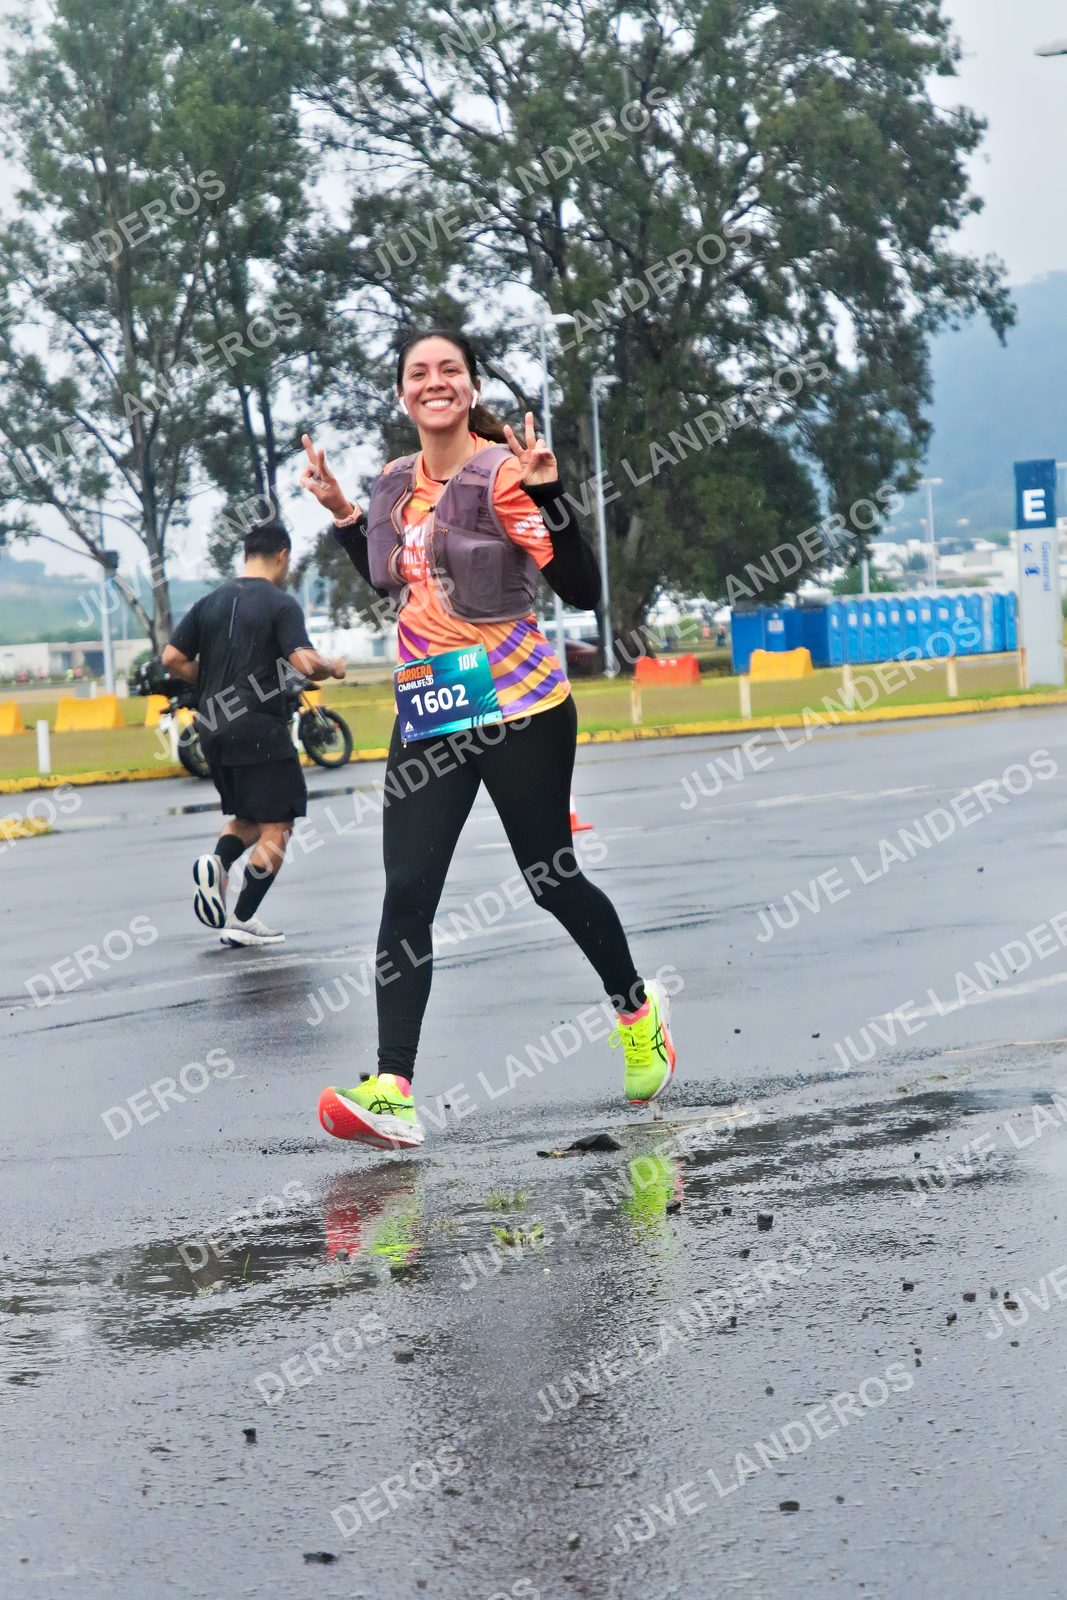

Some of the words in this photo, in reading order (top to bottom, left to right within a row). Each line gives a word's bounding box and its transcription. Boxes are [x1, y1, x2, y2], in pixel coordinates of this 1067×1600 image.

[1023, 488, 1047, 521] E
[397, 664, 433, 684] CARRERA
[457, 652, 479, 671] 10K
[410, 684, 469, 716] 1602
